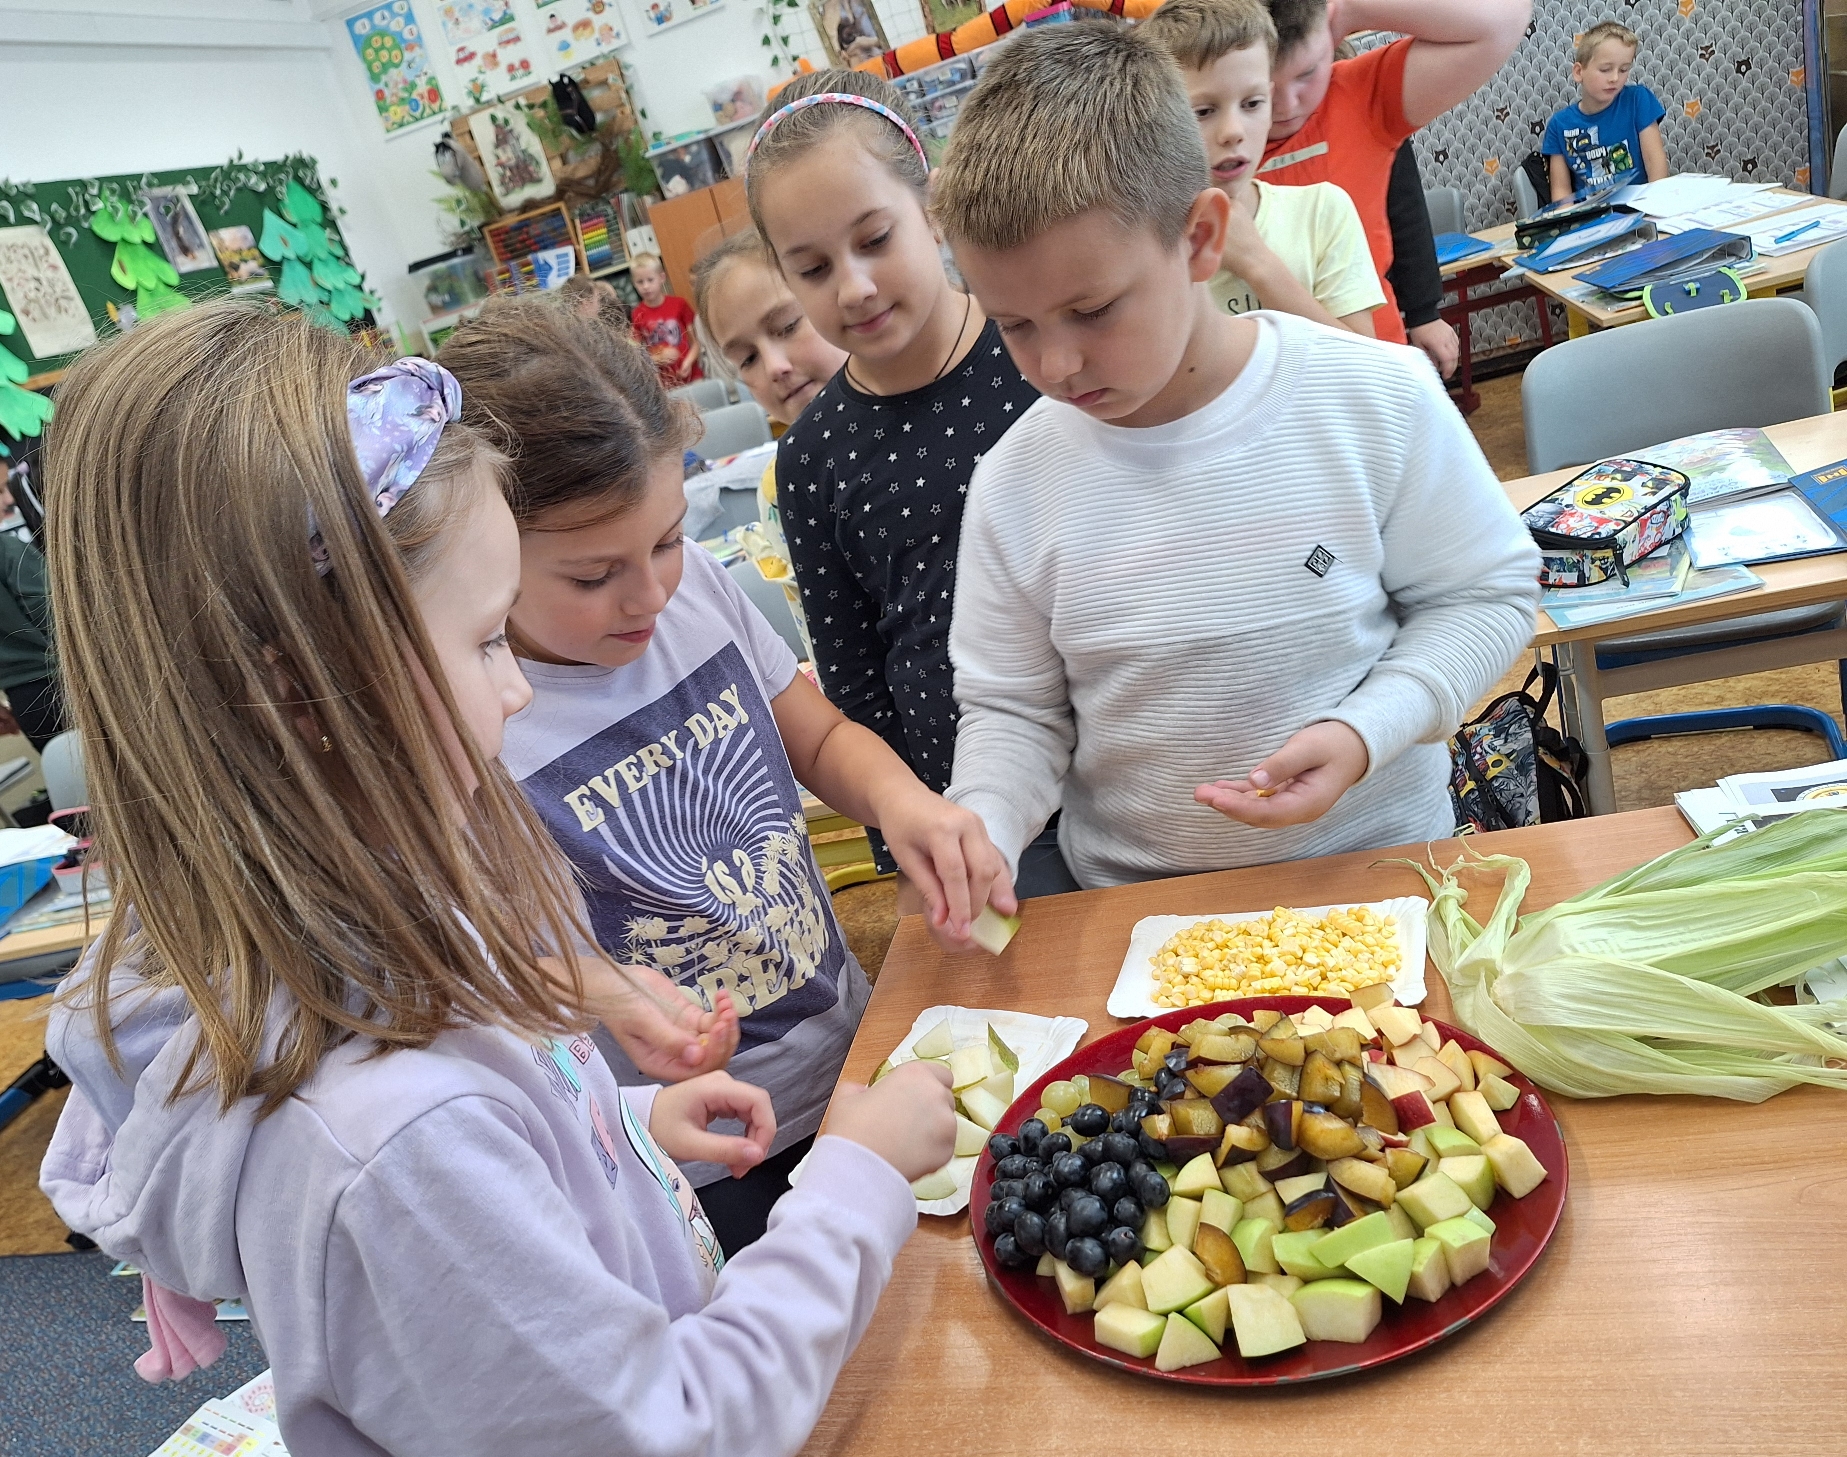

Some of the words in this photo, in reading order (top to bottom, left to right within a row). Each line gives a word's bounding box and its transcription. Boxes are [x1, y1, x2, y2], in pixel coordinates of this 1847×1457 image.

[563, 728, 686, 833] EVERY
[684, 683, 750, 751] DAY
[732, 848, 755, 893] a
[677, 894, 830, 1018] REAM
